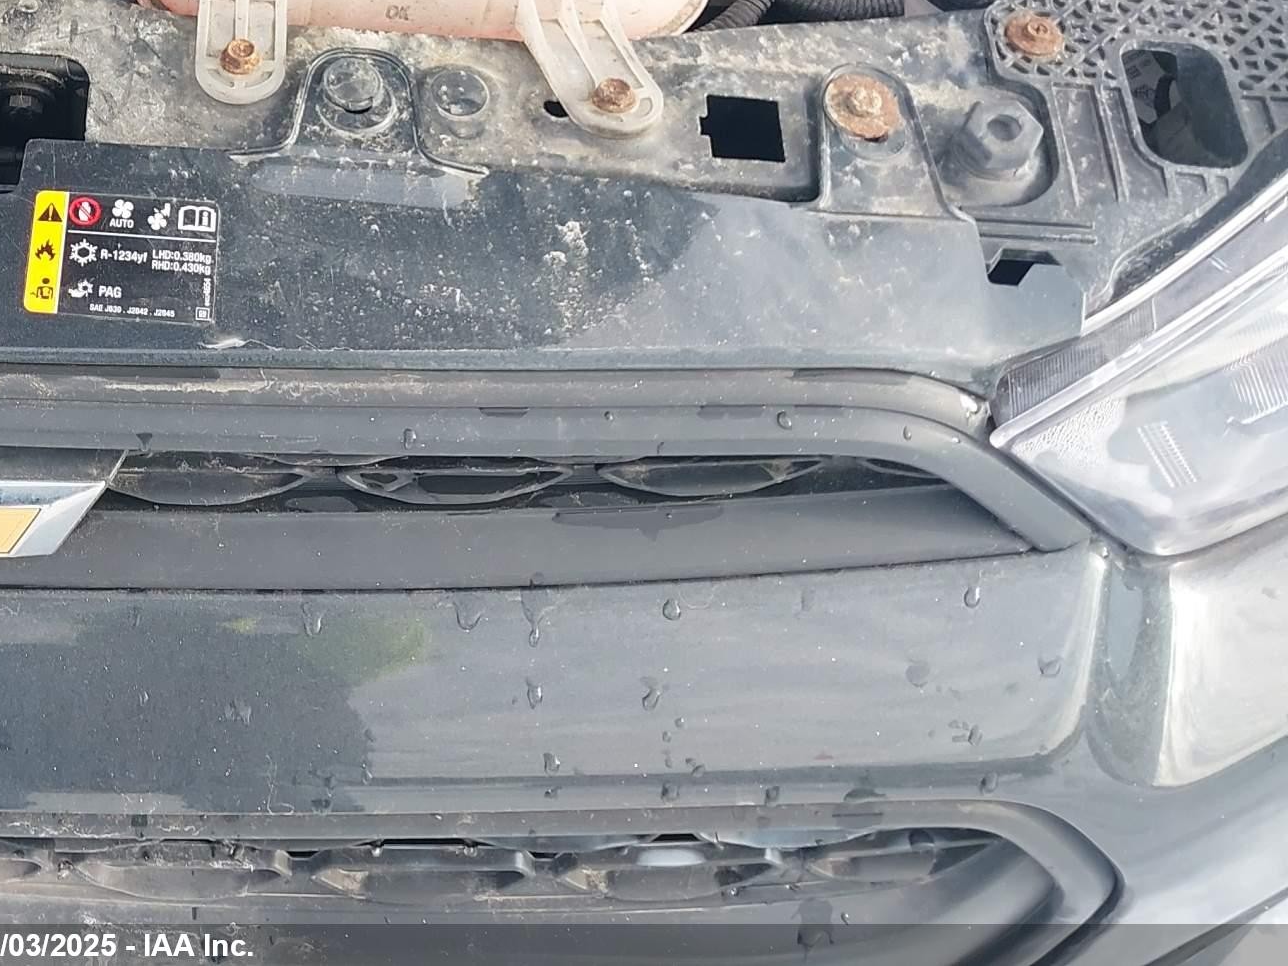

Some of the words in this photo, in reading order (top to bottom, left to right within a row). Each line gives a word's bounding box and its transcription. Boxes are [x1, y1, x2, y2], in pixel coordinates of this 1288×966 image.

[109, 219, 134, 228] AUTO
[100, 248, 148, 264] R-1234yf
[151, 260, 212, 276] RHD:0.430kg
[98, 285, 122, 299] PAG
